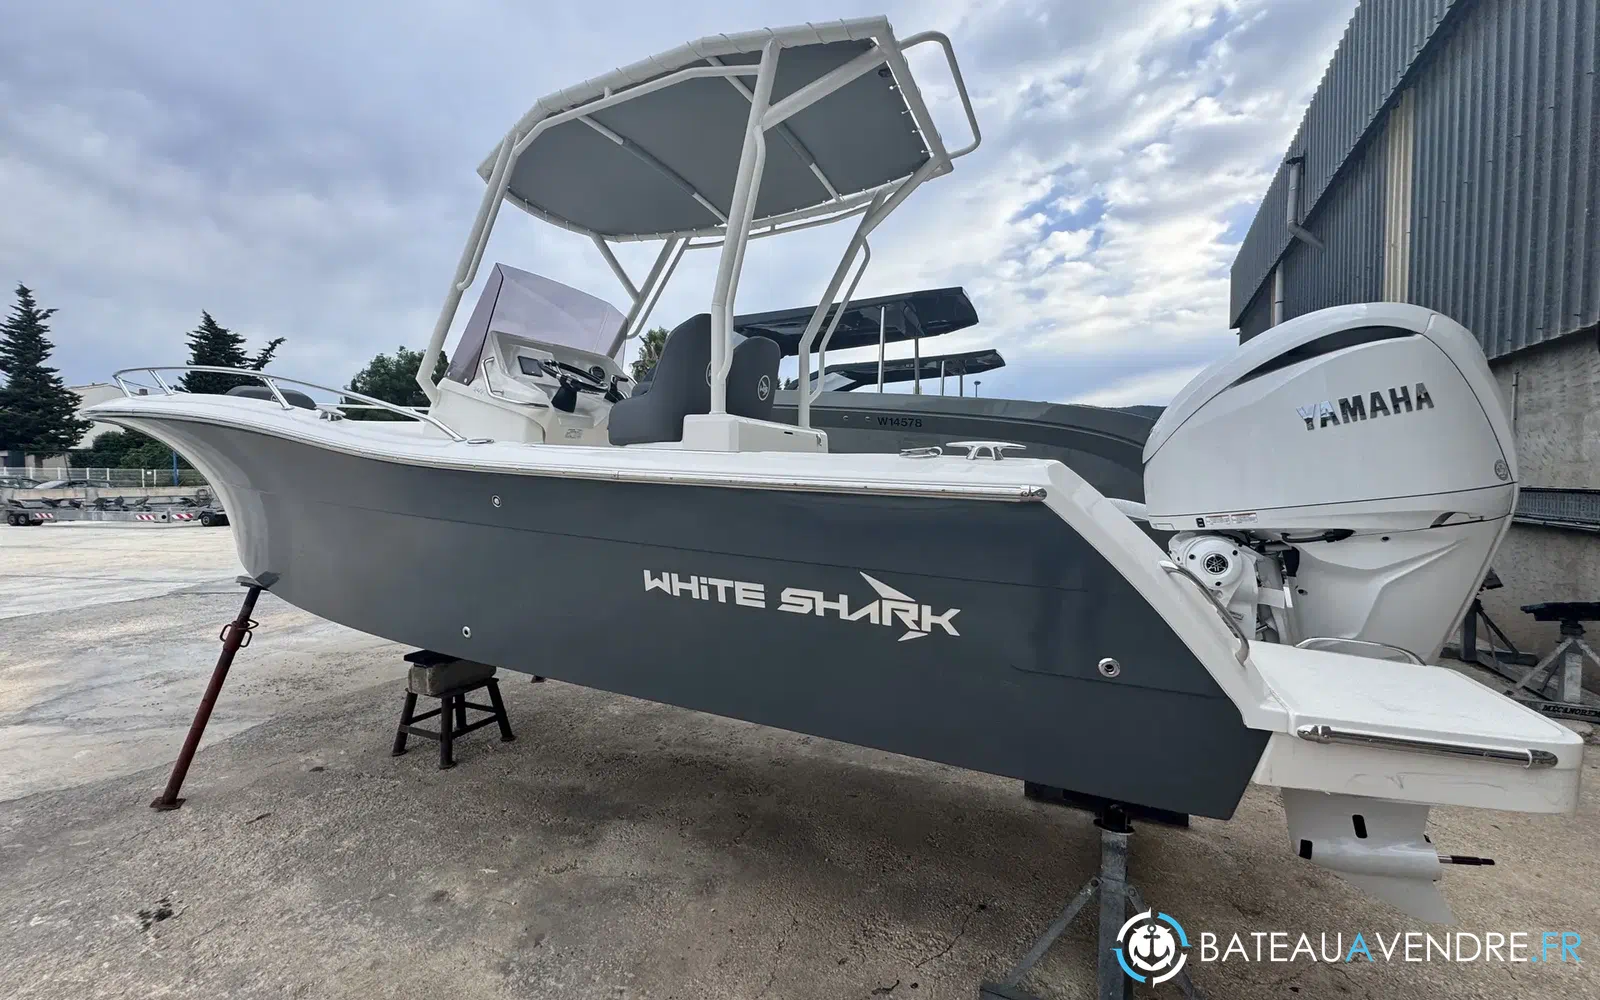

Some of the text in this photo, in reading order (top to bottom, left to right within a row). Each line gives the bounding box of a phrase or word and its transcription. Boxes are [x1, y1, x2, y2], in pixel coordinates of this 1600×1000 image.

[877, 416, 923, 428] W14578
[1296, 382, 1434, 431] YAMAHA
[777, 571, 961, 642] SHARK
